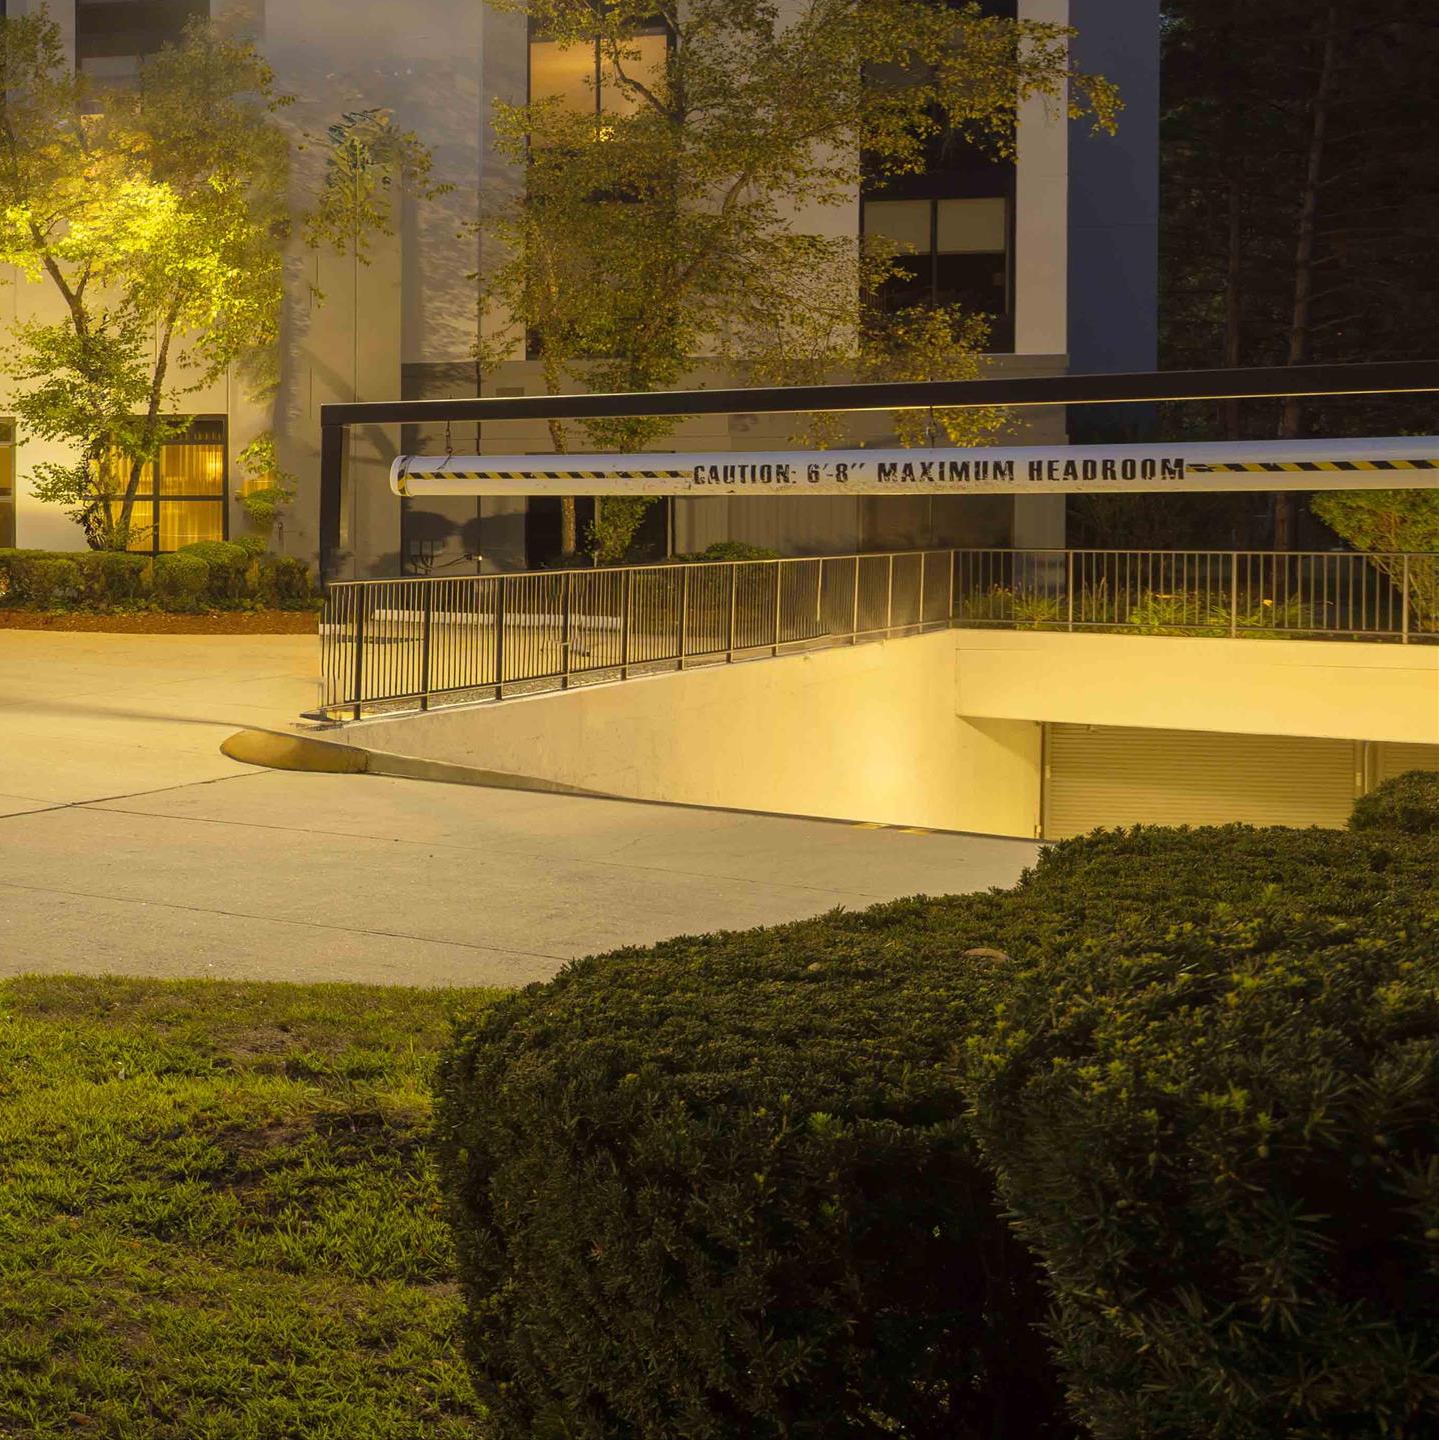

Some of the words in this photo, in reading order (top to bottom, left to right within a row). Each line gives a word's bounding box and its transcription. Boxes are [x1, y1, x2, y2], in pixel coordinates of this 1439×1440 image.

[693, 464, 798, 485] CAUTION:
[877, 460, 1014, 482] MAXIMUM
[1027, 458, 1185, 481] HEADROOM
